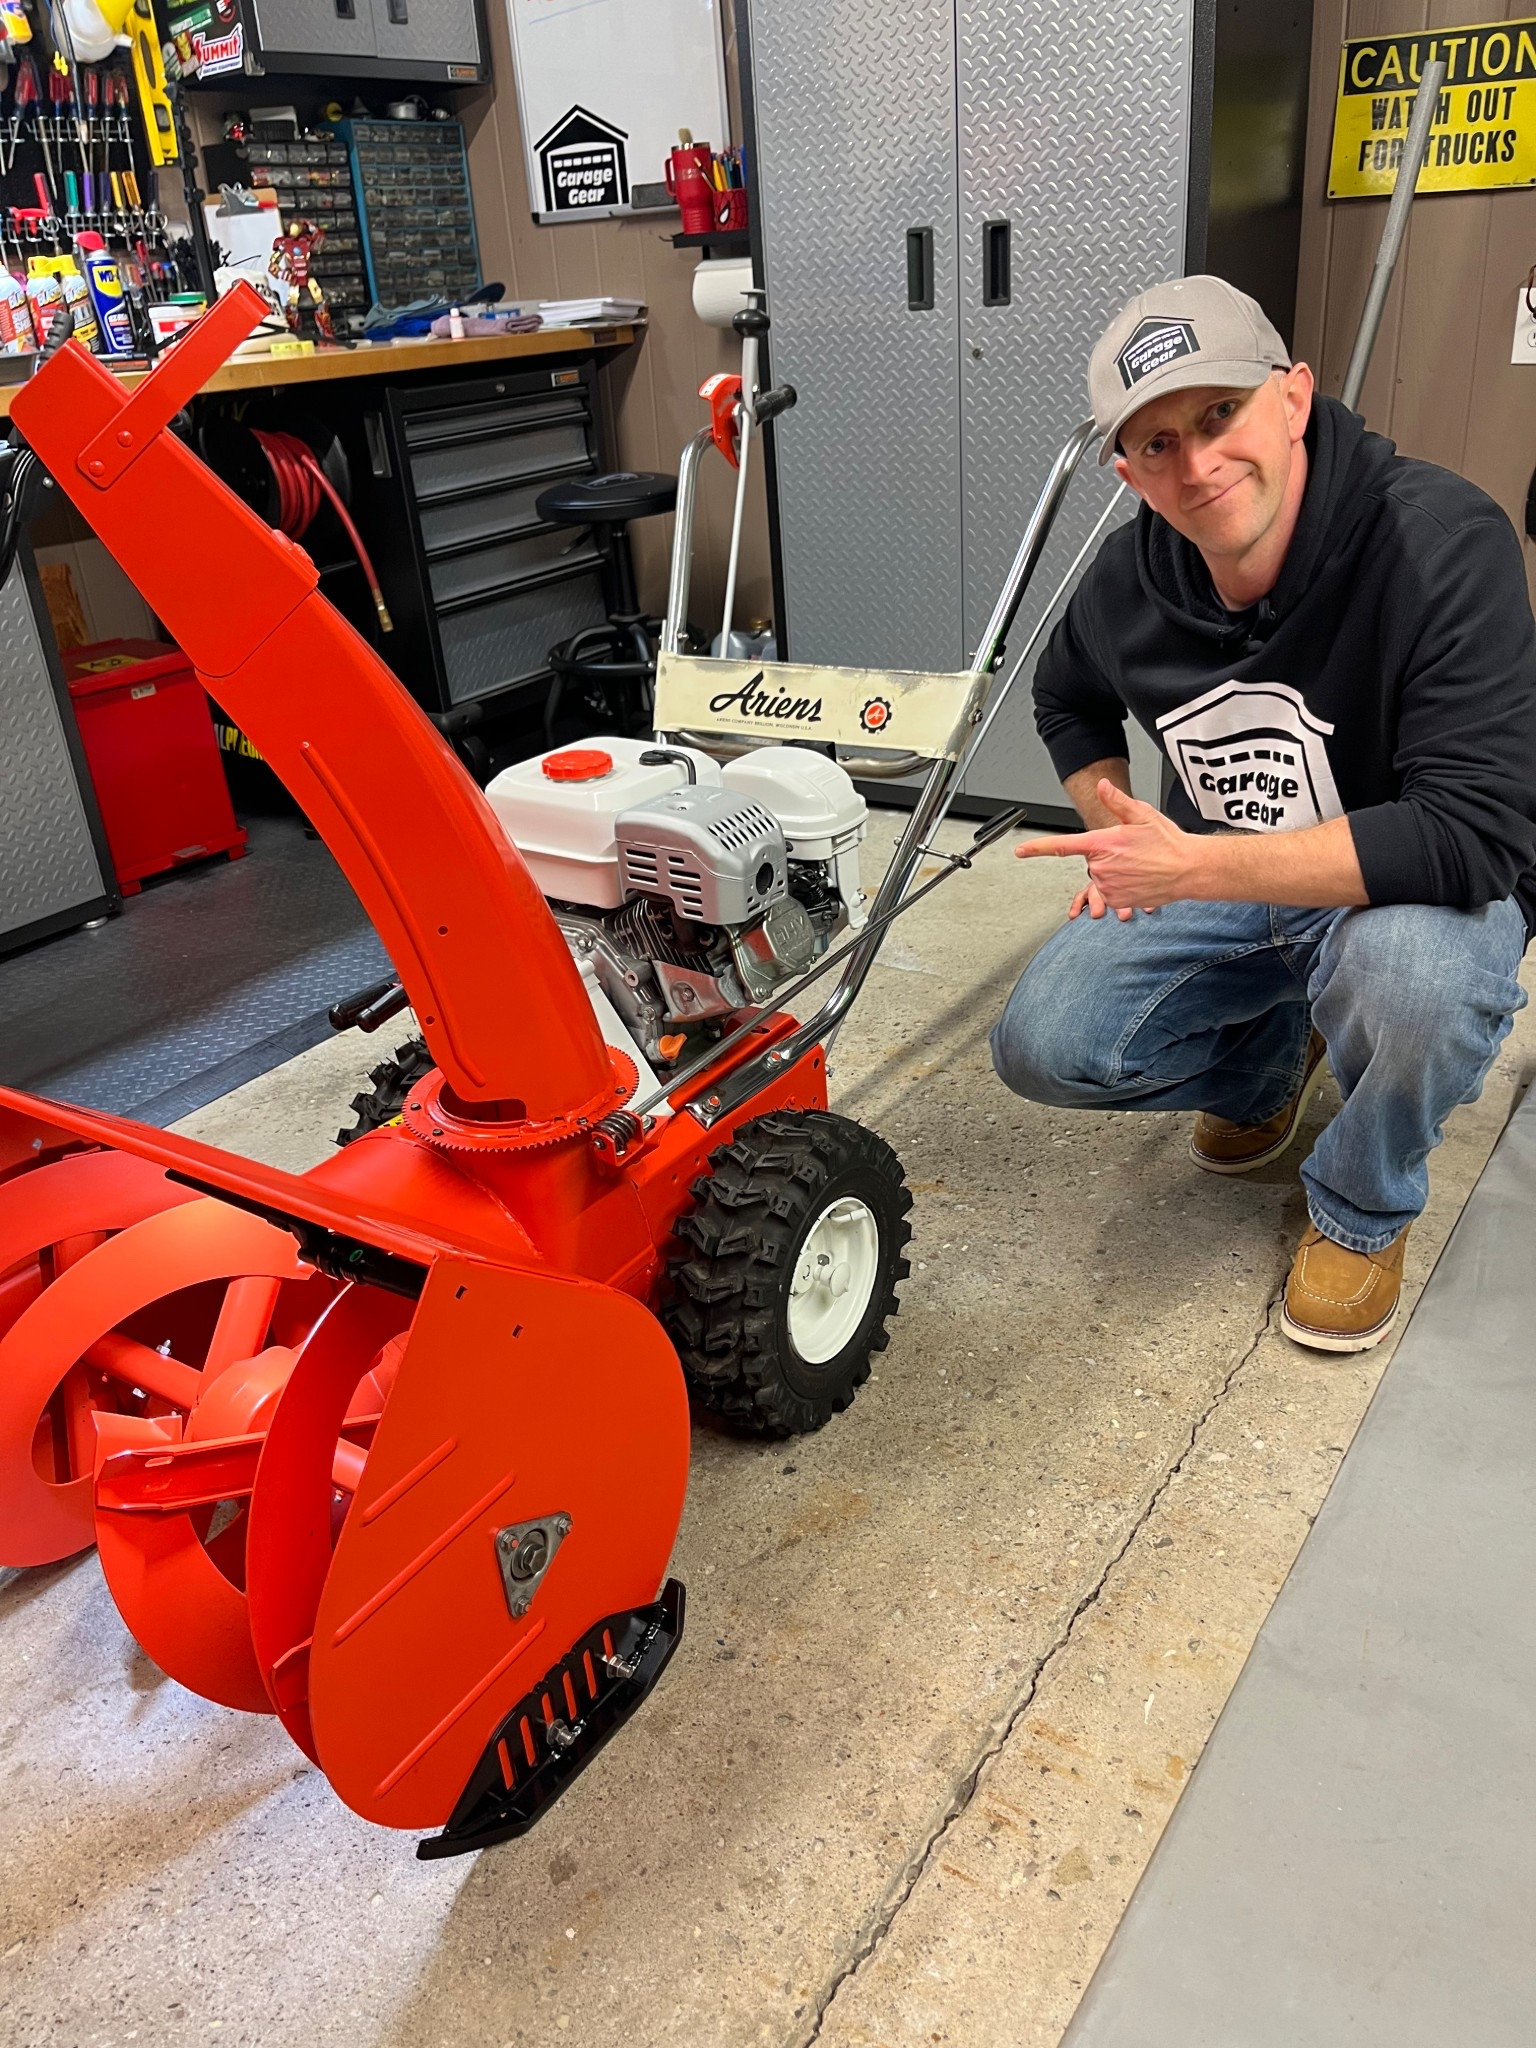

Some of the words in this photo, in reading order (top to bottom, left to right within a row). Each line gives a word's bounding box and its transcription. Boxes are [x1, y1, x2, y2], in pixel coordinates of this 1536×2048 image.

[194, 31, 241, 65] SUMMIT
[1351, 30, 1536, 88] CAUTION
[1372, 92, 1451, 131] WATH
[1466, 86, 1517, 123] OUT
[1358, 138, 1404, 172] FOR
[1421, 129, 1517, 167] TRUCKS
[557, 168, 613, 188] Garage
[568, 187, 605, 205] Gear
[1131, 336, 1183, 369] Garage
[1141, 349, 1177, 373] Gear
[709, 670, 822, 722] Ariens
[1199, 771, 1299, 800] Garage
[1224, 799, 1285, 827] Gear
